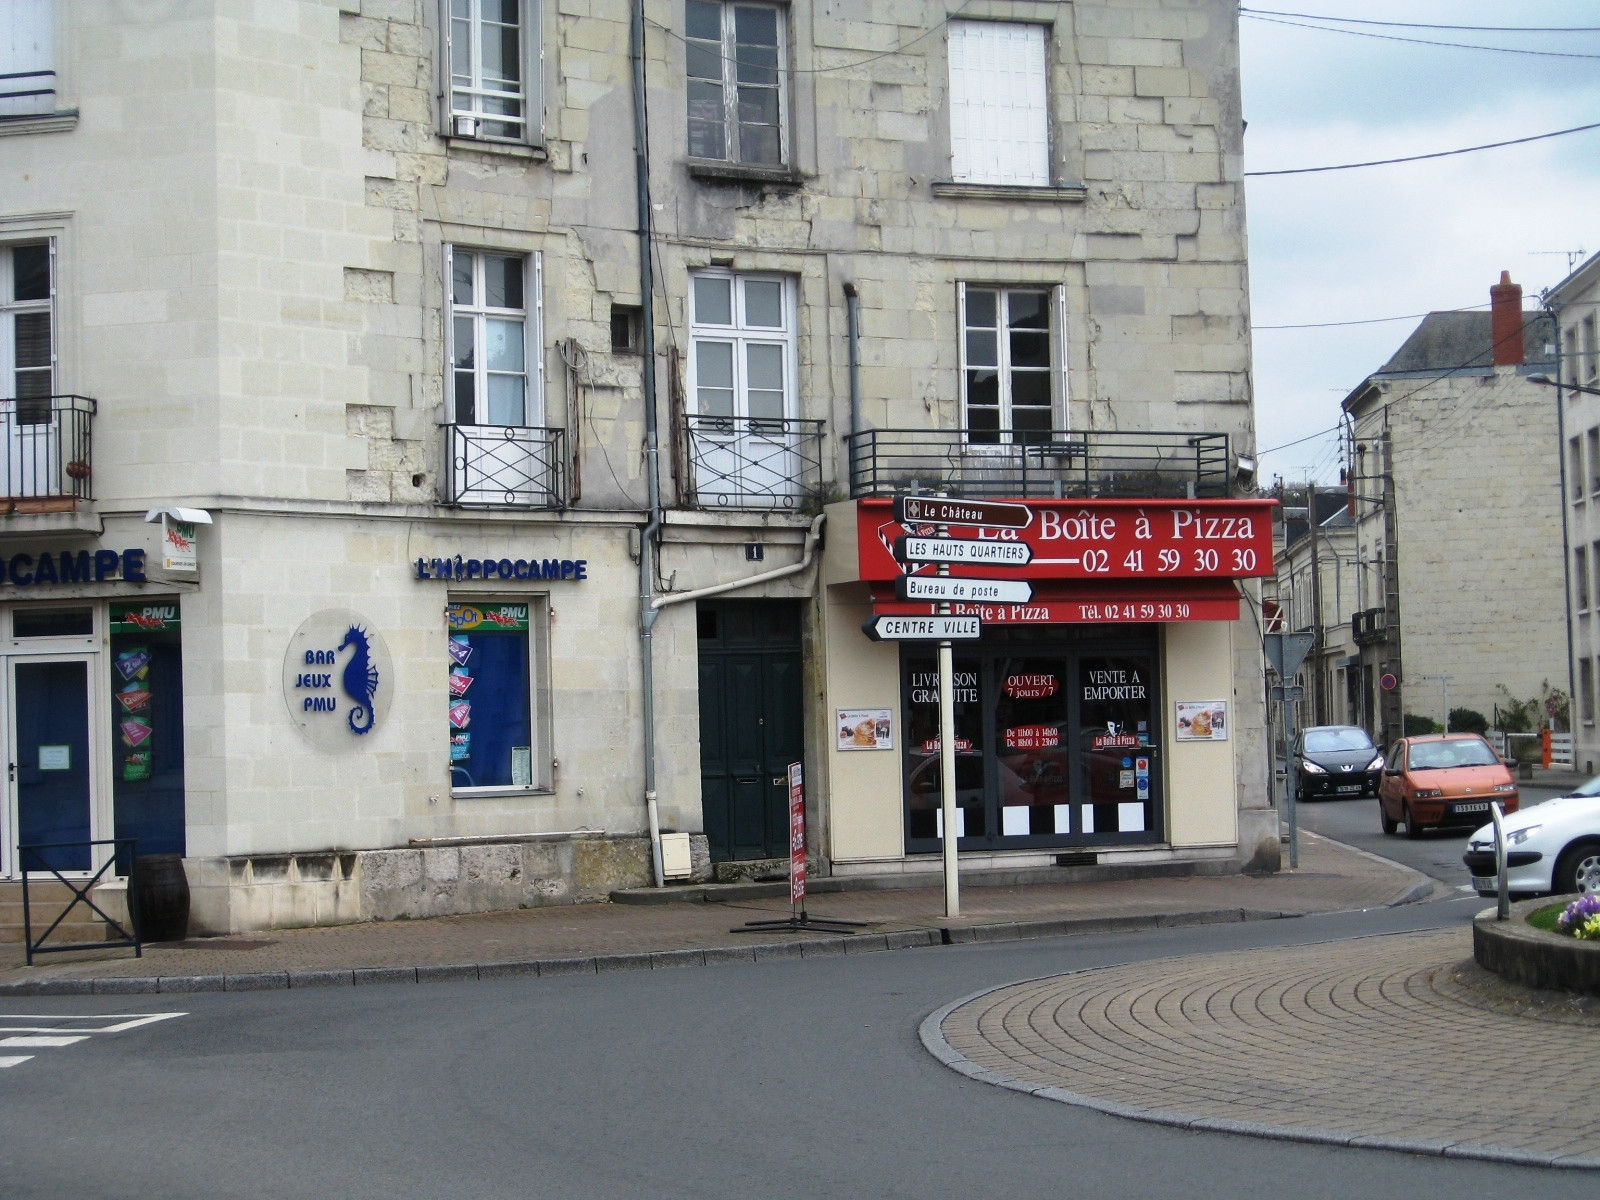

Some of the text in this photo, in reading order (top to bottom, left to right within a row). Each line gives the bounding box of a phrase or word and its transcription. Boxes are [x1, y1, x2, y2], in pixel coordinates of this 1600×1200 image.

[924, 504, 983, 520] Le Château
[1038, 509, 1116, 540] Boîte
[1135, 509, 1152, 539] à
[1171, 509, 1254, 539] Pizza
[909, 542, 1024, 559] LES HAUTS QUARTIERS
[0, 548, 147, 586] CAMPE
[1082, 548, 1256, 572] 02 41 59 30 30
[910, 581, 999, 599] Bureau de poste
[142, 606, 175, 619] PMU
[500, 606, 526, 619] PMU
[955, 603, 993, 620] Boîte
[998, 605, 1006, 620] à
[1011, 605, 1049, 620] Pizza
[1079, 604, 1190, 619] Tél. 02 41 59 30 30
[885, 620, 977, 634] CENTRE VILLE
[305, 649, 336, 665] BAR
[295, 673, 332, 688] JEUX
[912, 672, 977, 687] LIVRSON
[1008, 675, 1055, 687] OUVERT
[1089, 670, 1140, 684] VENTE A
[912, 689, 978, 703] GRAITE
[1008, 688, 1013, 697] 7
[1016, 688, 1040, 699] jours
[1048, 687, 1054, 696] 7
[1084, 685, 1146, 700] EMPORTER
[304, 697, 336, 712] PMU
[1006, 729, 1015, 737] De
[1006, 739, 1015, 747] De
[1041, 738, 1058, 746] 23h00
[1095, 736, 1102, 746] La
[1121, 736, 1135, 745] Pizza
